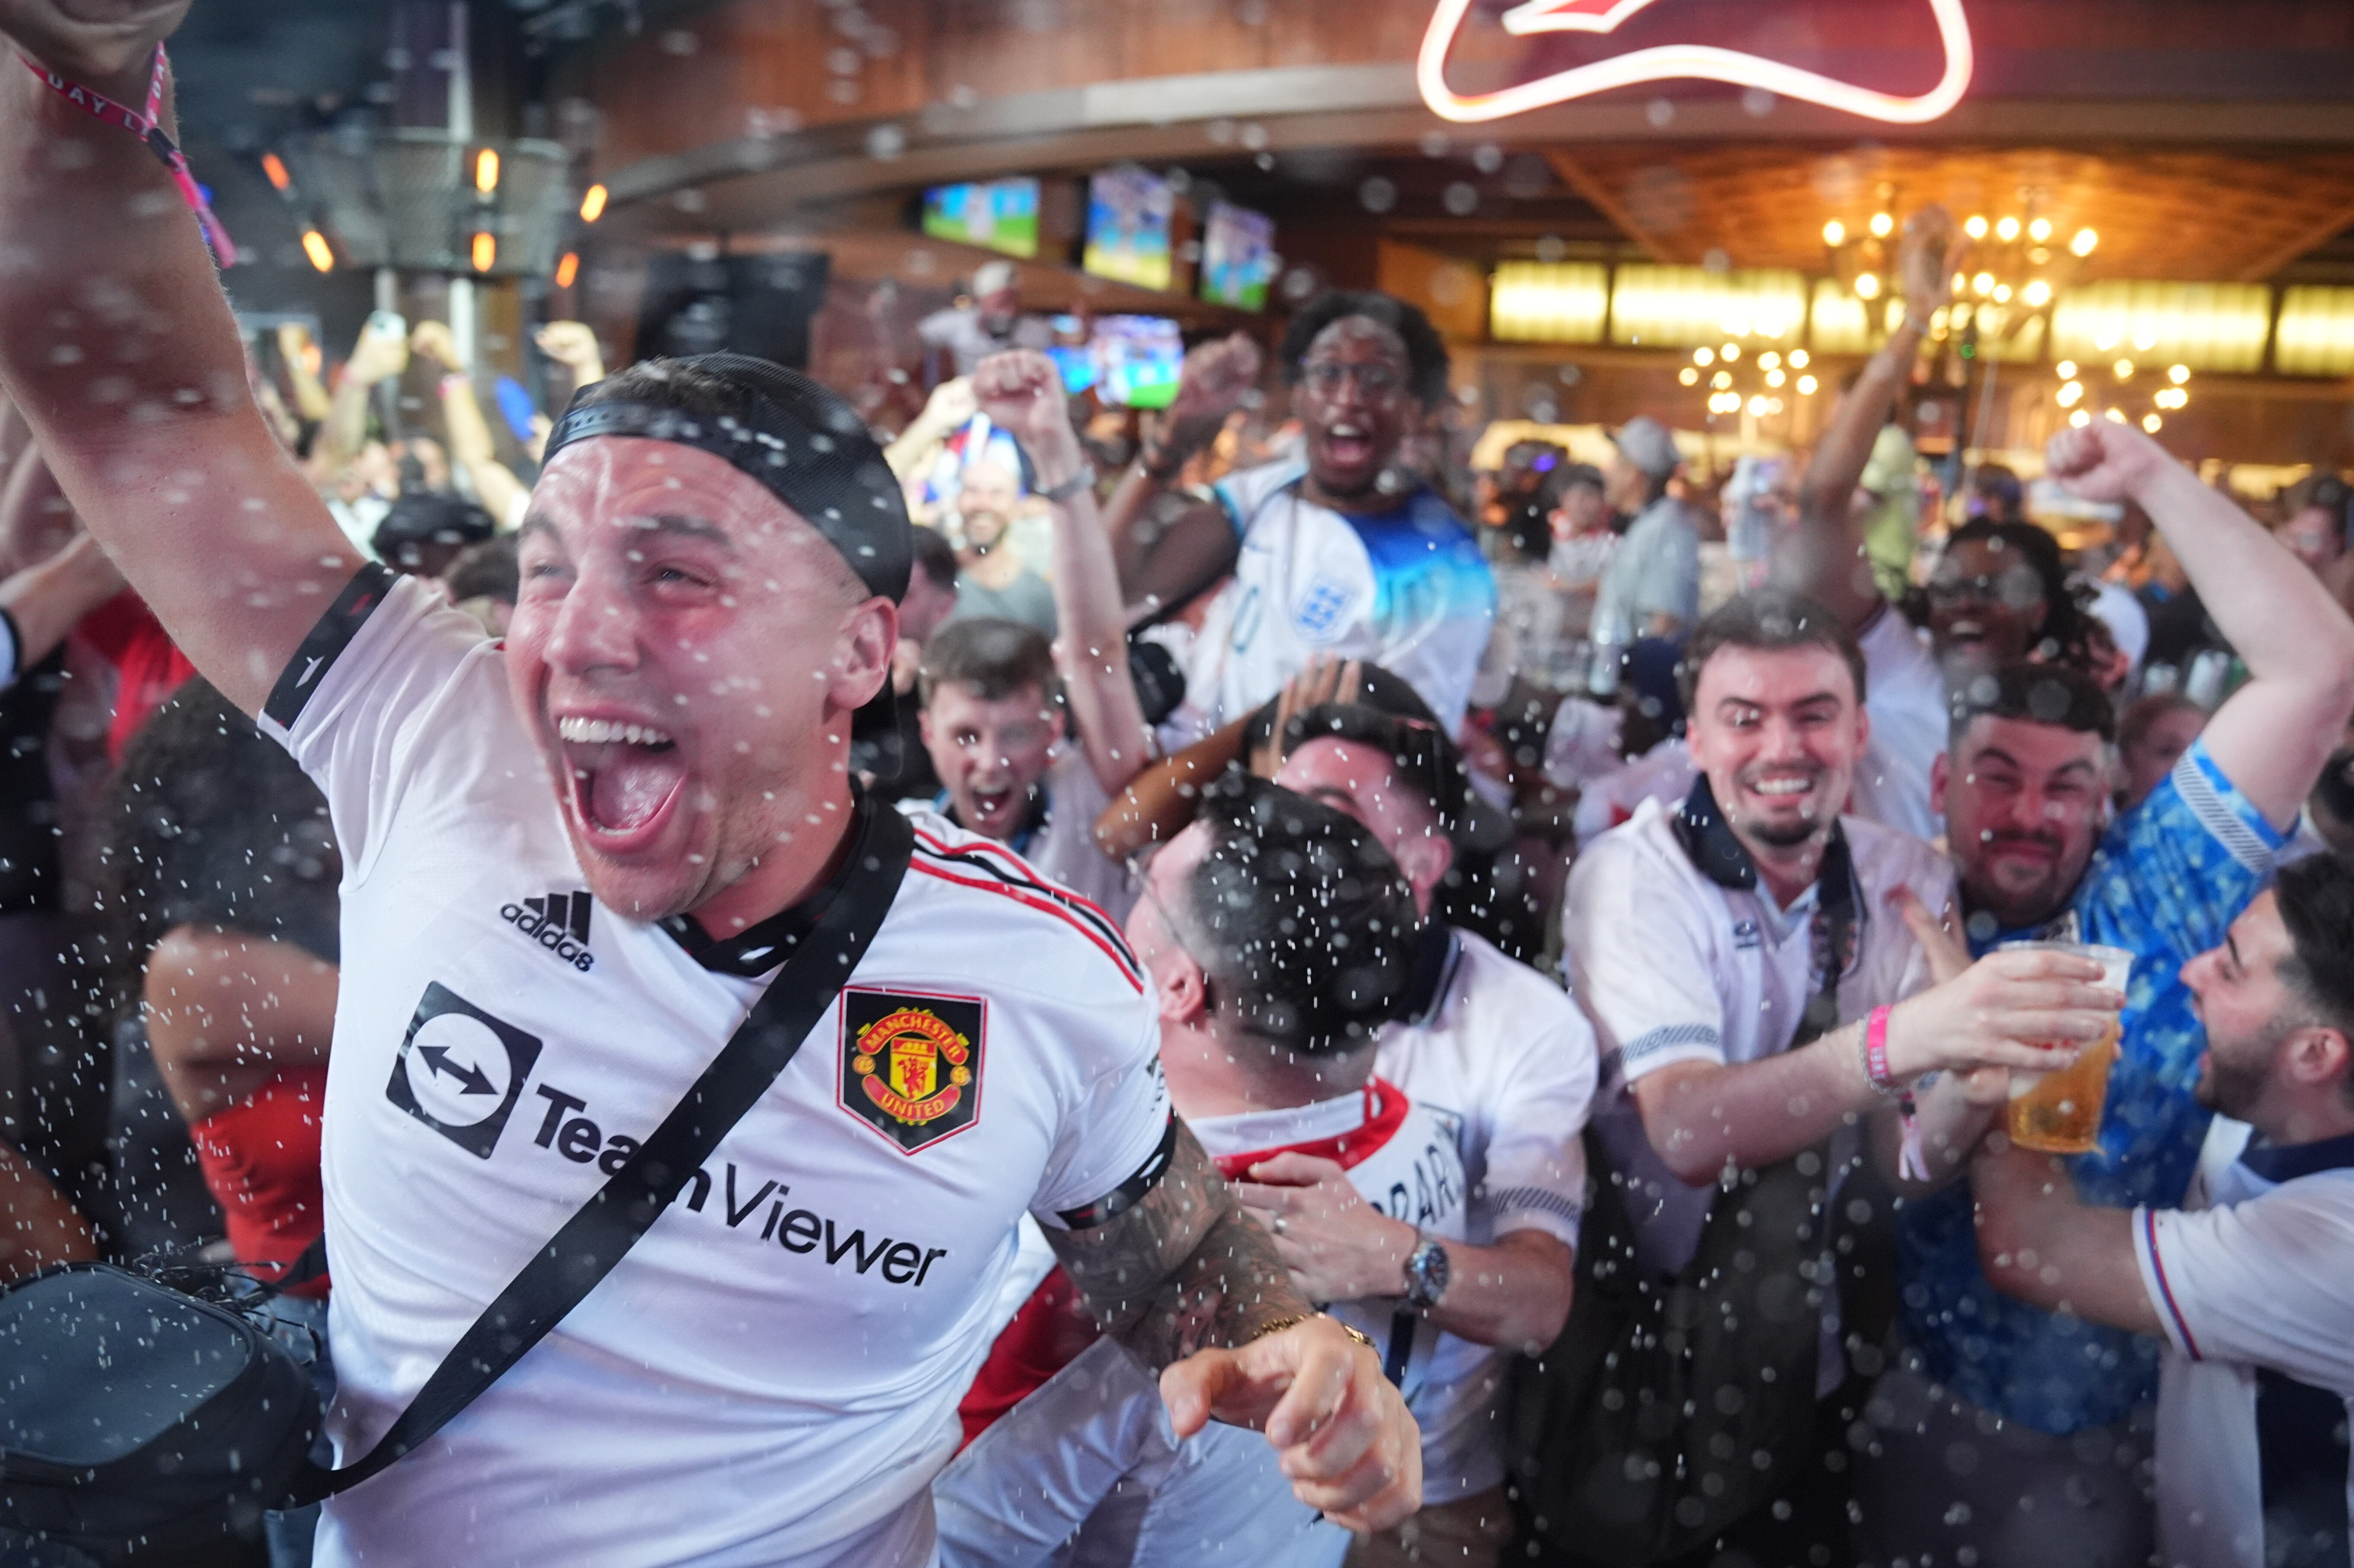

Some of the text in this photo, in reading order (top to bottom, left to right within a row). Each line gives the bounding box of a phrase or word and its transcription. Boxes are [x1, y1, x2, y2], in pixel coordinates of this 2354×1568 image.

[48, 73, 107, 114] DAY
[500, 903, 595, 973] adidas
[865, 1015, 961, 1058] MANCHESTER
[881, 1093, 945, 1118] UNITED
